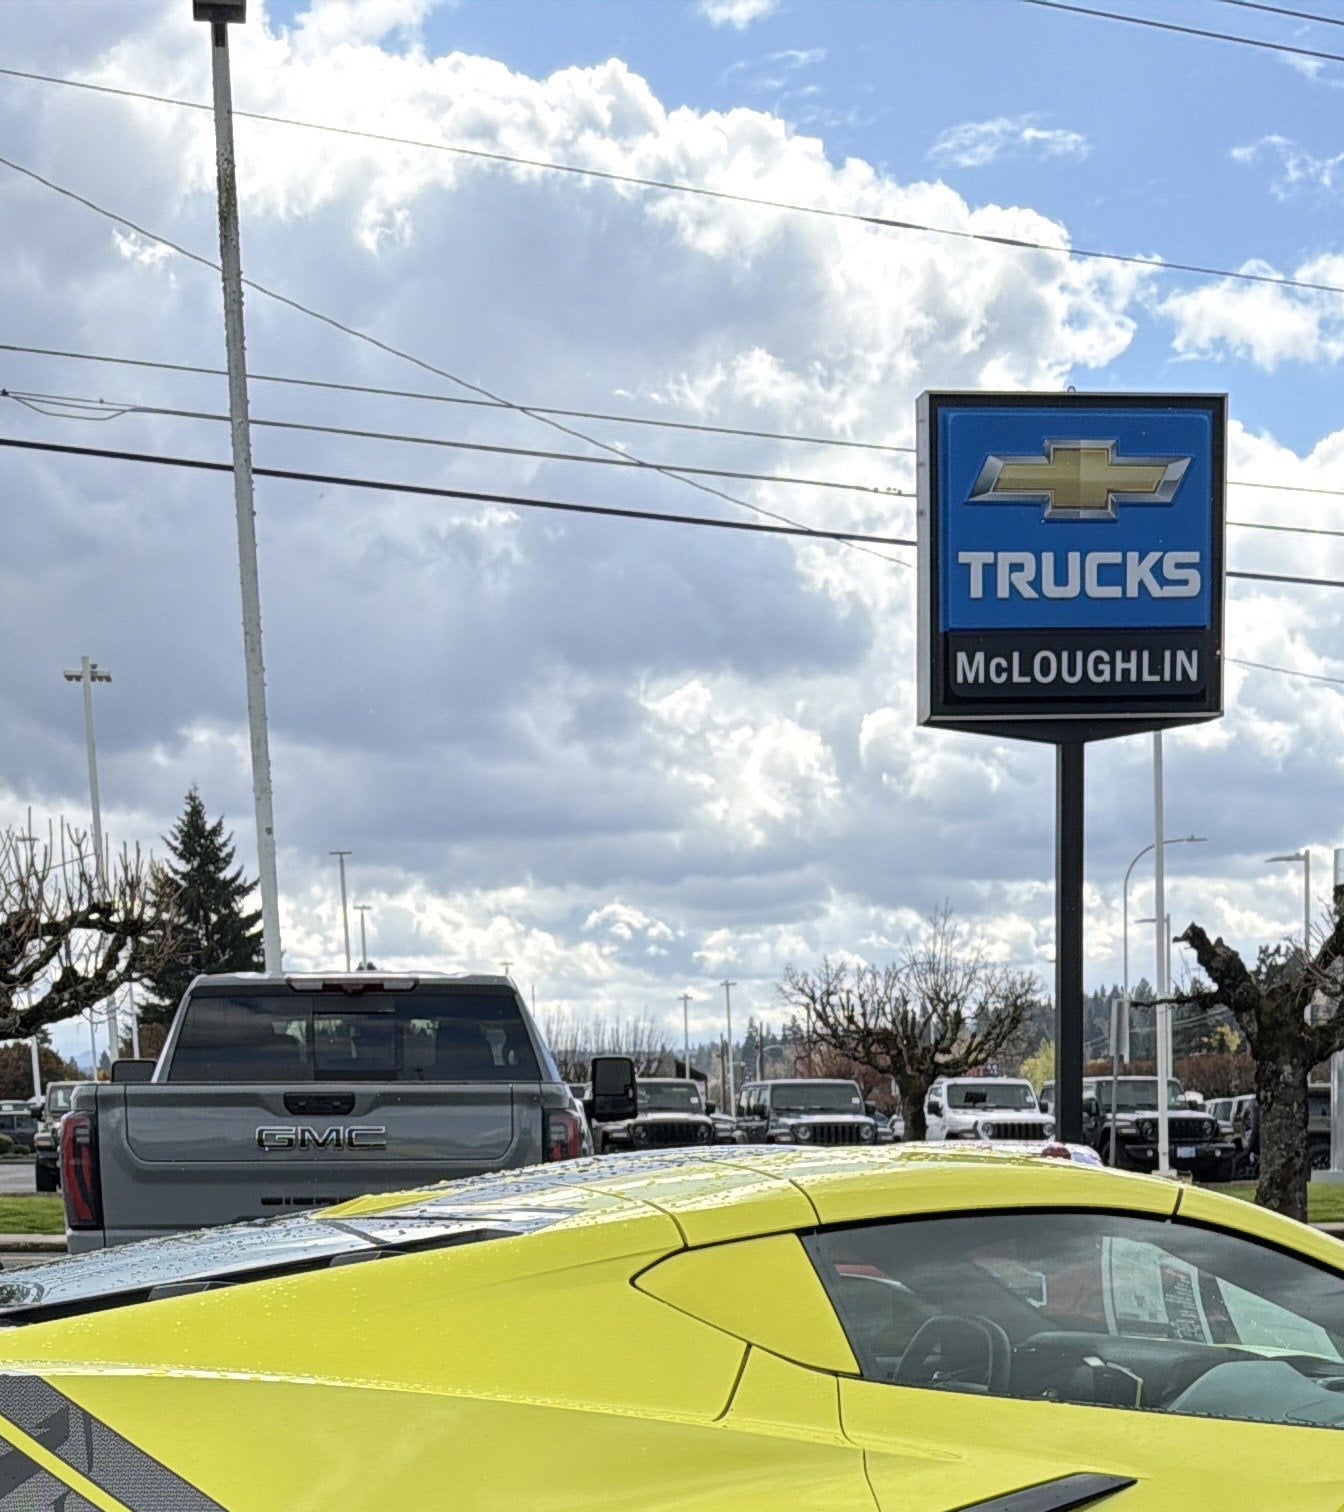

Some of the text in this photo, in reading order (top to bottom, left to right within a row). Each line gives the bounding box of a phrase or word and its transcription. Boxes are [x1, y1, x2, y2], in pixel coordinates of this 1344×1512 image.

[958, 551, 1201, 599] TRUCKS
[956, 650, 1198, 684] McLOUGHLIN
[256, 1126, 386, 1150] GMC
